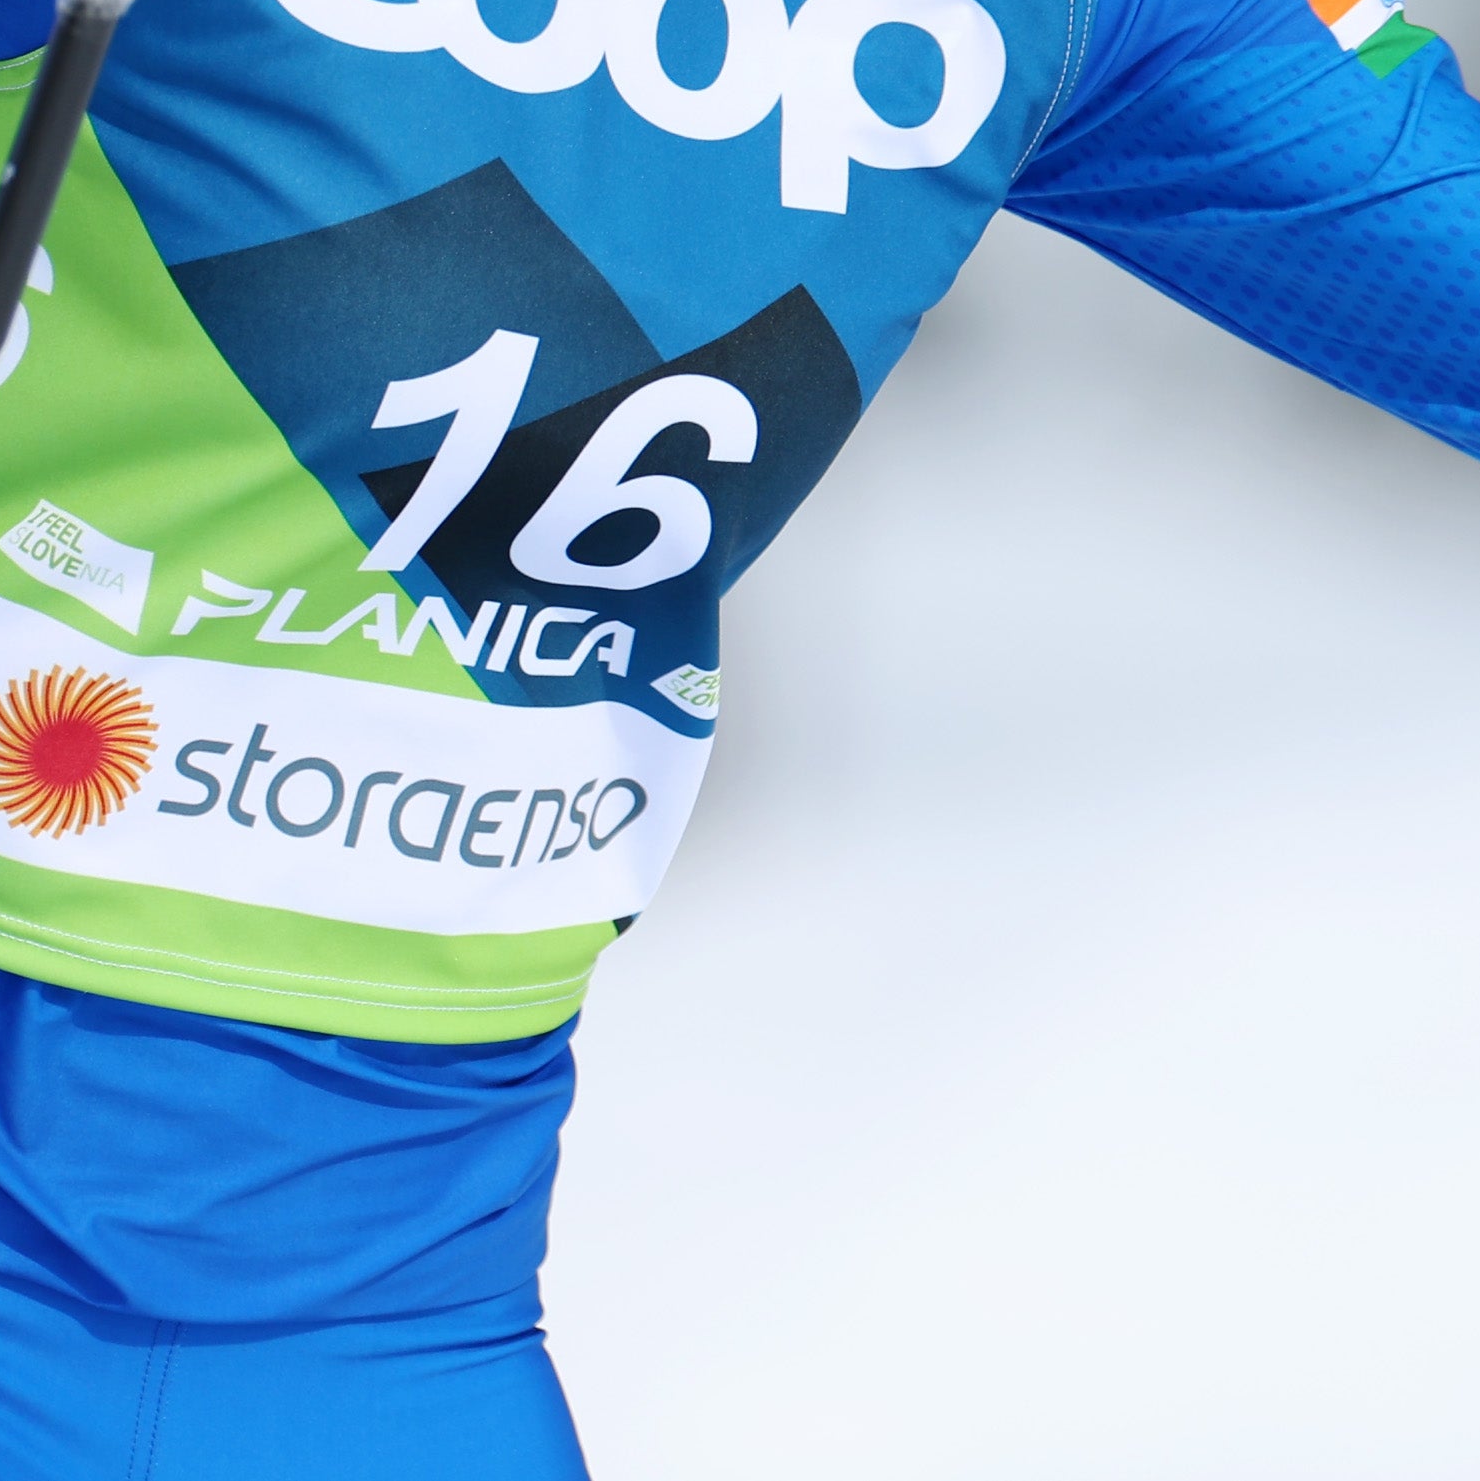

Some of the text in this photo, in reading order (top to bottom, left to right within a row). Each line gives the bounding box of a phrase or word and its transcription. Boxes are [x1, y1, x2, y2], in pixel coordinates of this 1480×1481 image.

[358, 328, 759, 591] 16
[9, 526, 126, 595] SLOVENIA
[28, 507, 84, 554] I FEEL
[171, 568, 637, 678] PLANICA
